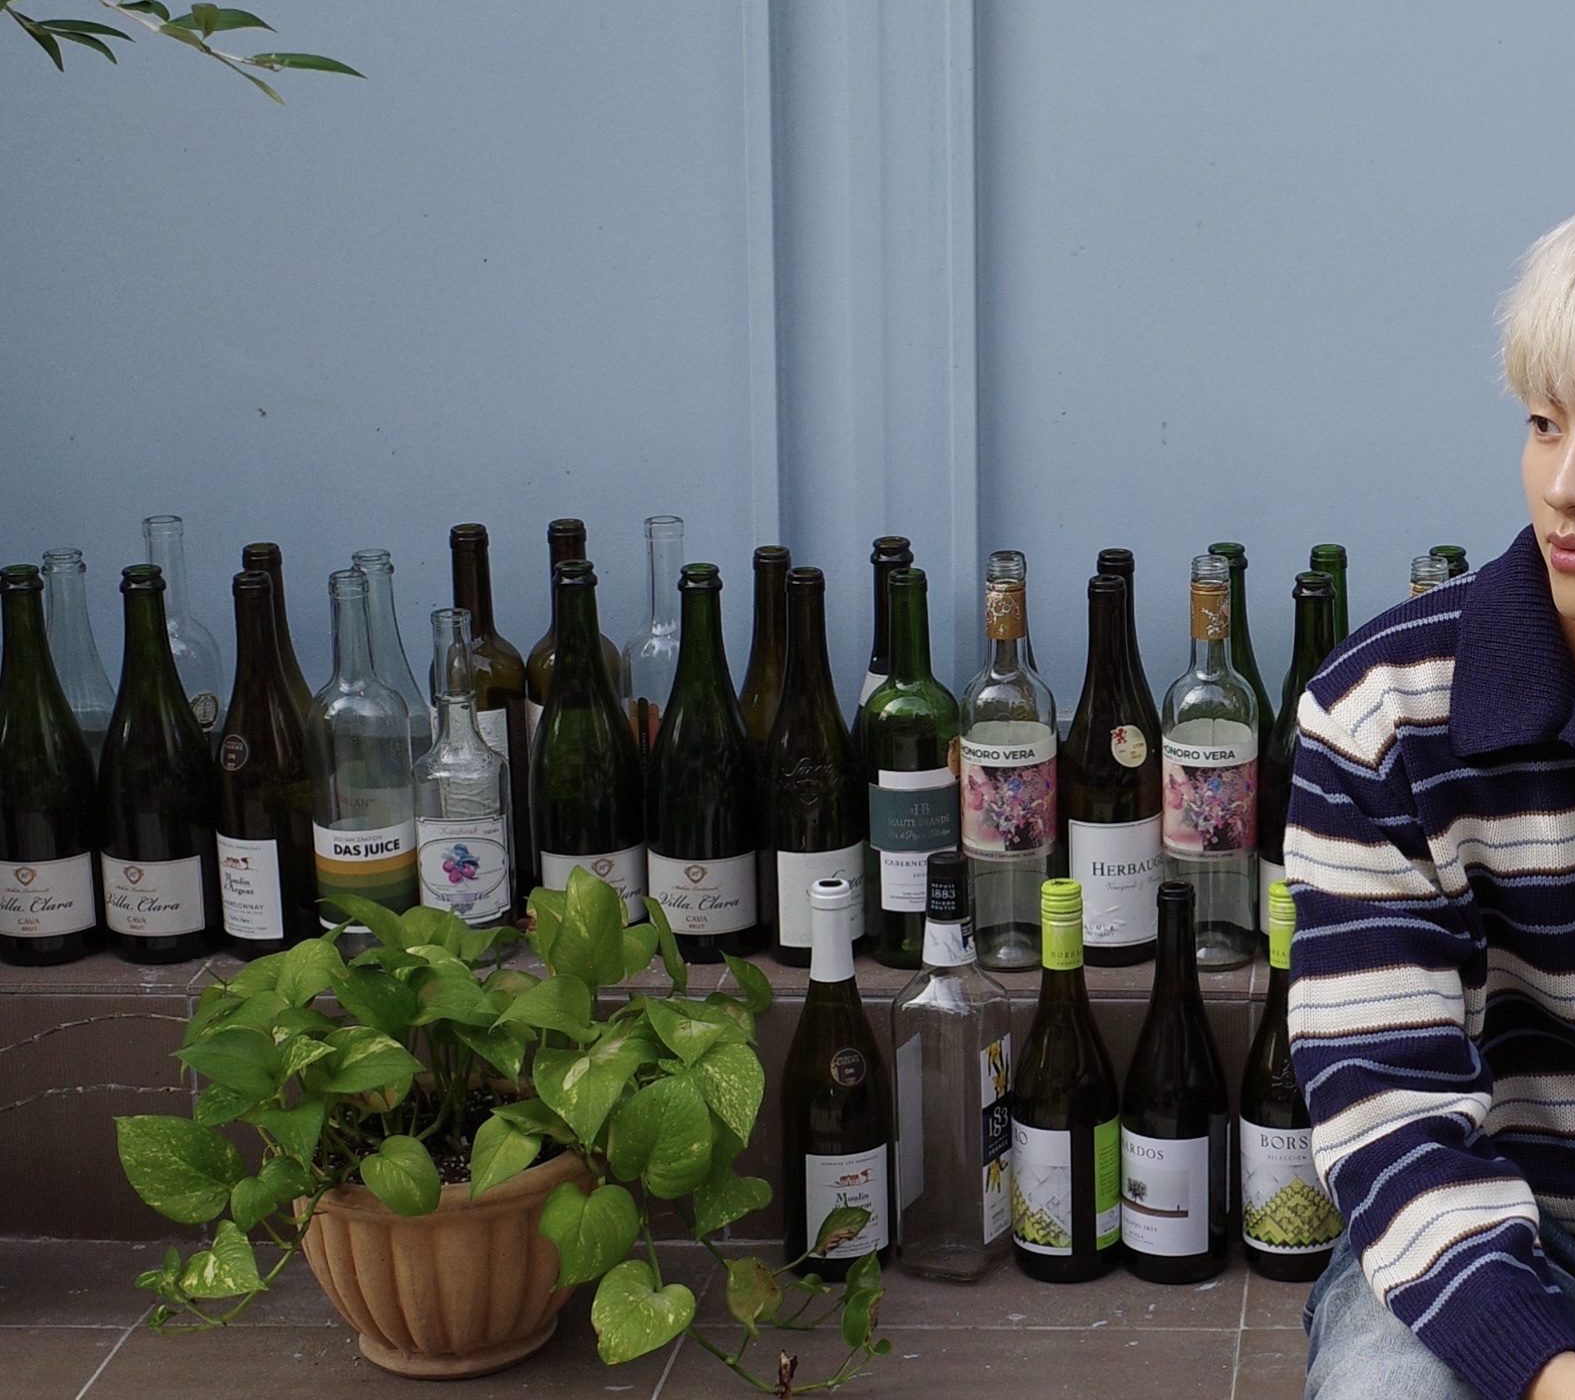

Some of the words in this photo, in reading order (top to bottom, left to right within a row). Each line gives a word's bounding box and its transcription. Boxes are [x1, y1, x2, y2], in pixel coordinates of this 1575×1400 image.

[1003, 749, 1035, 760] VERA
[1203, 750, 1235, 760] VERA
[334, 844, 361, 856] DAS
[364, 839, 400, 857] JUICE
[931, 889, 956, 899] 1883
[29, 896, 74, 913] Clara
[137, 896, 181, 913] Clara
[698, 893, 740, 911] Clara
[126, 916, 147, 924] CAVA
[685, 915, 708, 923] CAVA
[1260, 1133, 1311, 1149] BORS
[836, 1192, 870, 1207] Moulin
